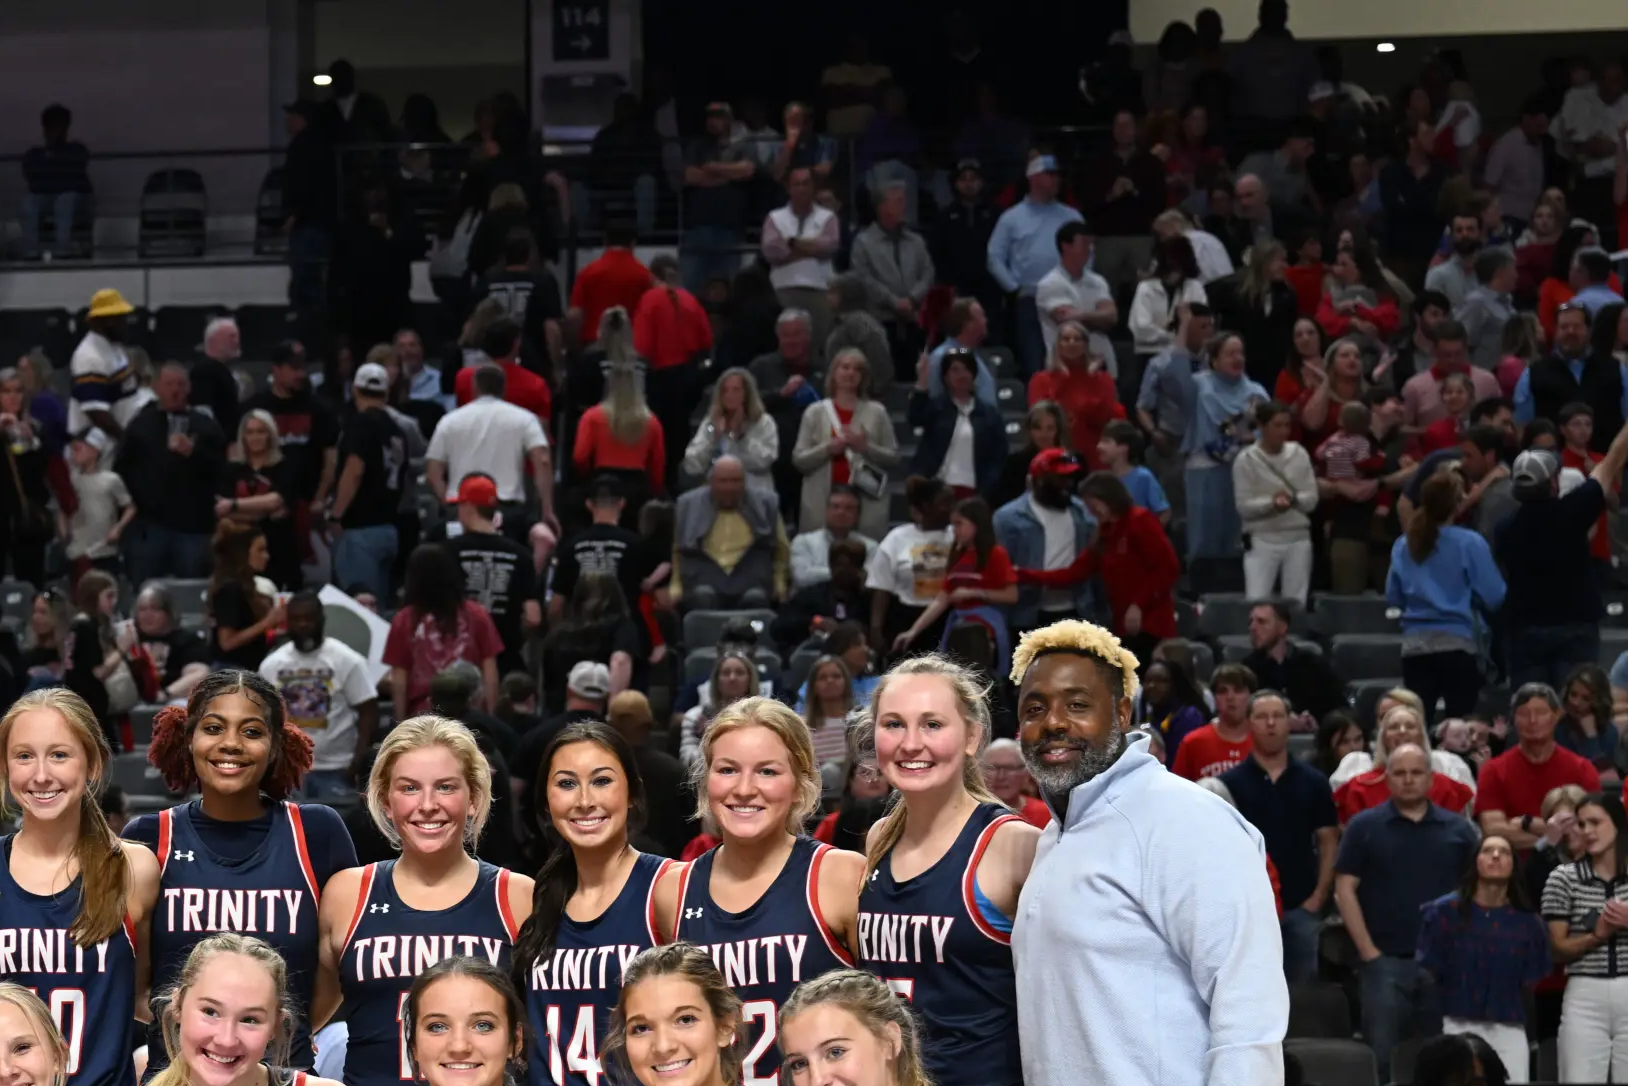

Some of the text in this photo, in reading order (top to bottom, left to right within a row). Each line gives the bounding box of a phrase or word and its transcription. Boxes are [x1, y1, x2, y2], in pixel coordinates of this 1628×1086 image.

[163, 887, 304, 935] TRINITY
[857, 911, 956, 964] RINITY
[523, 943, 641, 991] RINITY
[697, 933, 809, 989] INITY
[27, 986, 87, 1077] 0
[395, 989, 428, 1081] 1
